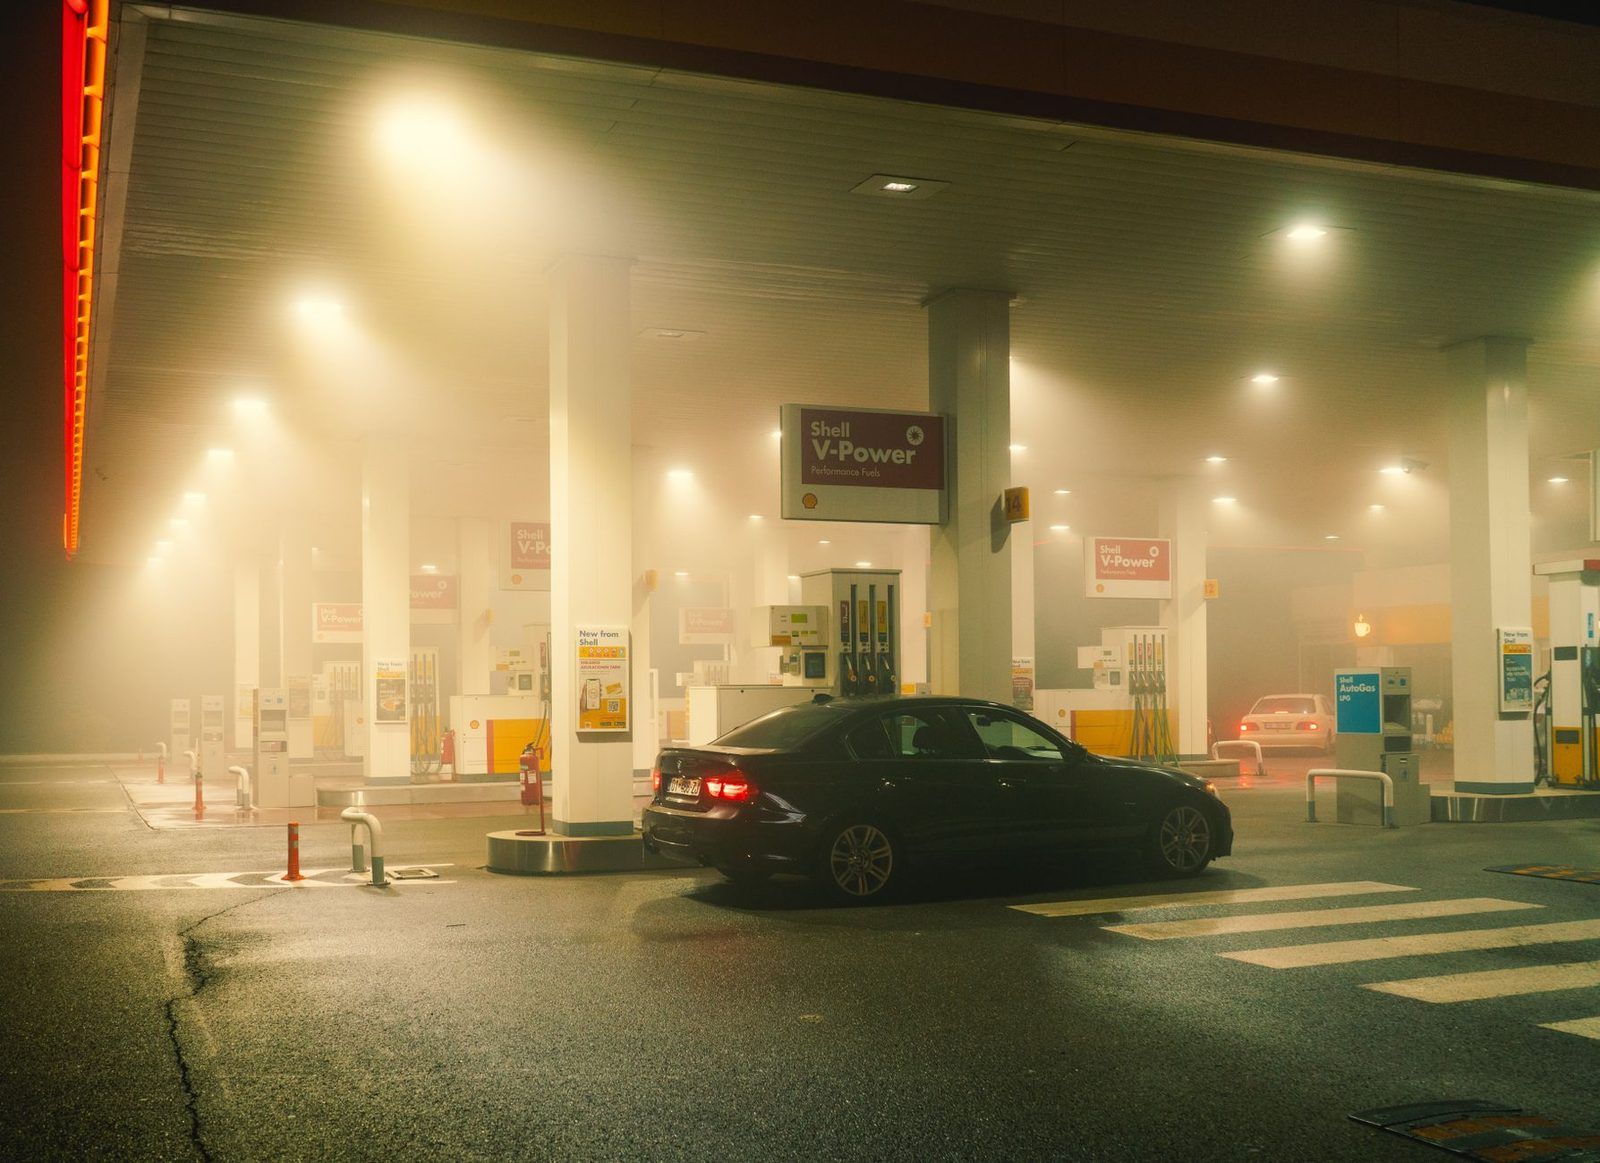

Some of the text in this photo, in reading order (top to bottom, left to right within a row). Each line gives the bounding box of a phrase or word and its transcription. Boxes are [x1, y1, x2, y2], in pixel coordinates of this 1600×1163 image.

[810, 421, 850, 438] Shell
[811, 439, 917, 465] V-Power
[810, 465, 881, 478] Performance Fuels
[517, 528, 544, 540] Shell
[518, 540, 551, 555] V-Po
[1099, 544, 1121, 555] Shell
[1101, 555, 1155, 569] V-Power
[411, 590, 443, 600] ower
[579, 629, 619, 638] New from
[579, 638, 599, 646] Shell
[1339, 676, 1354, 684] Shell
[1339, 683, 1376, 693] AutoGas
[1339, 694, 1351, 702] LPG
